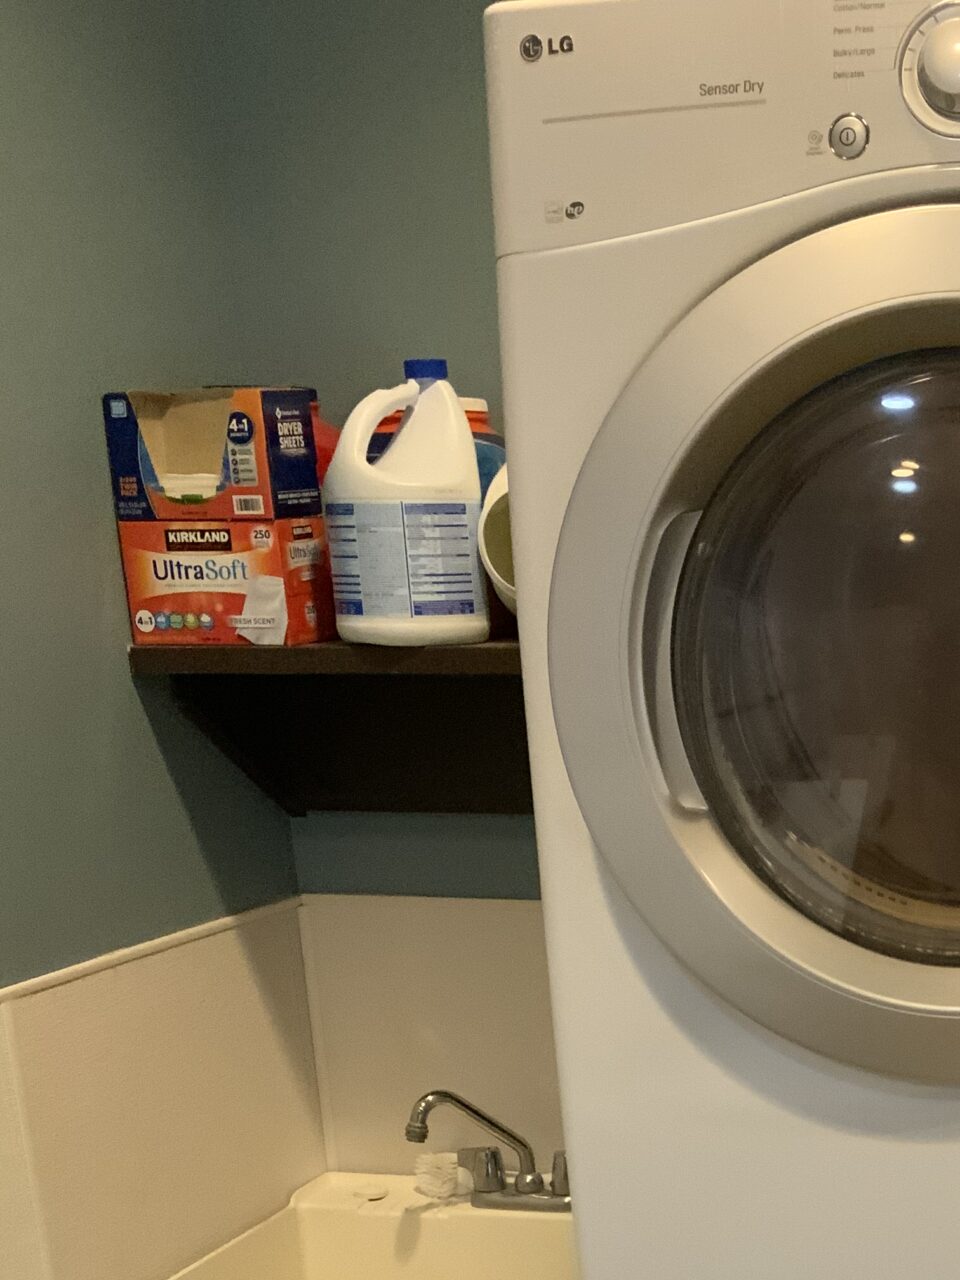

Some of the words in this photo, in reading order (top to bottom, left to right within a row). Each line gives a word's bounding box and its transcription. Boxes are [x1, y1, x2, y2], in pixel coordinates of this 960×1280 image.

[547, 35, 574, 56] LG
[699, 82, 741, 97] Sensor
[743, 79, 765, 94] Dry
[277, 421, 303, 436] DRYER
[279, 436, 305, 449] SHEETS
[167, 531, 229, 543] KIRKLAND
[253, 529, 271, 539] 250
[152, 559, 249, 581] UltraSoft
